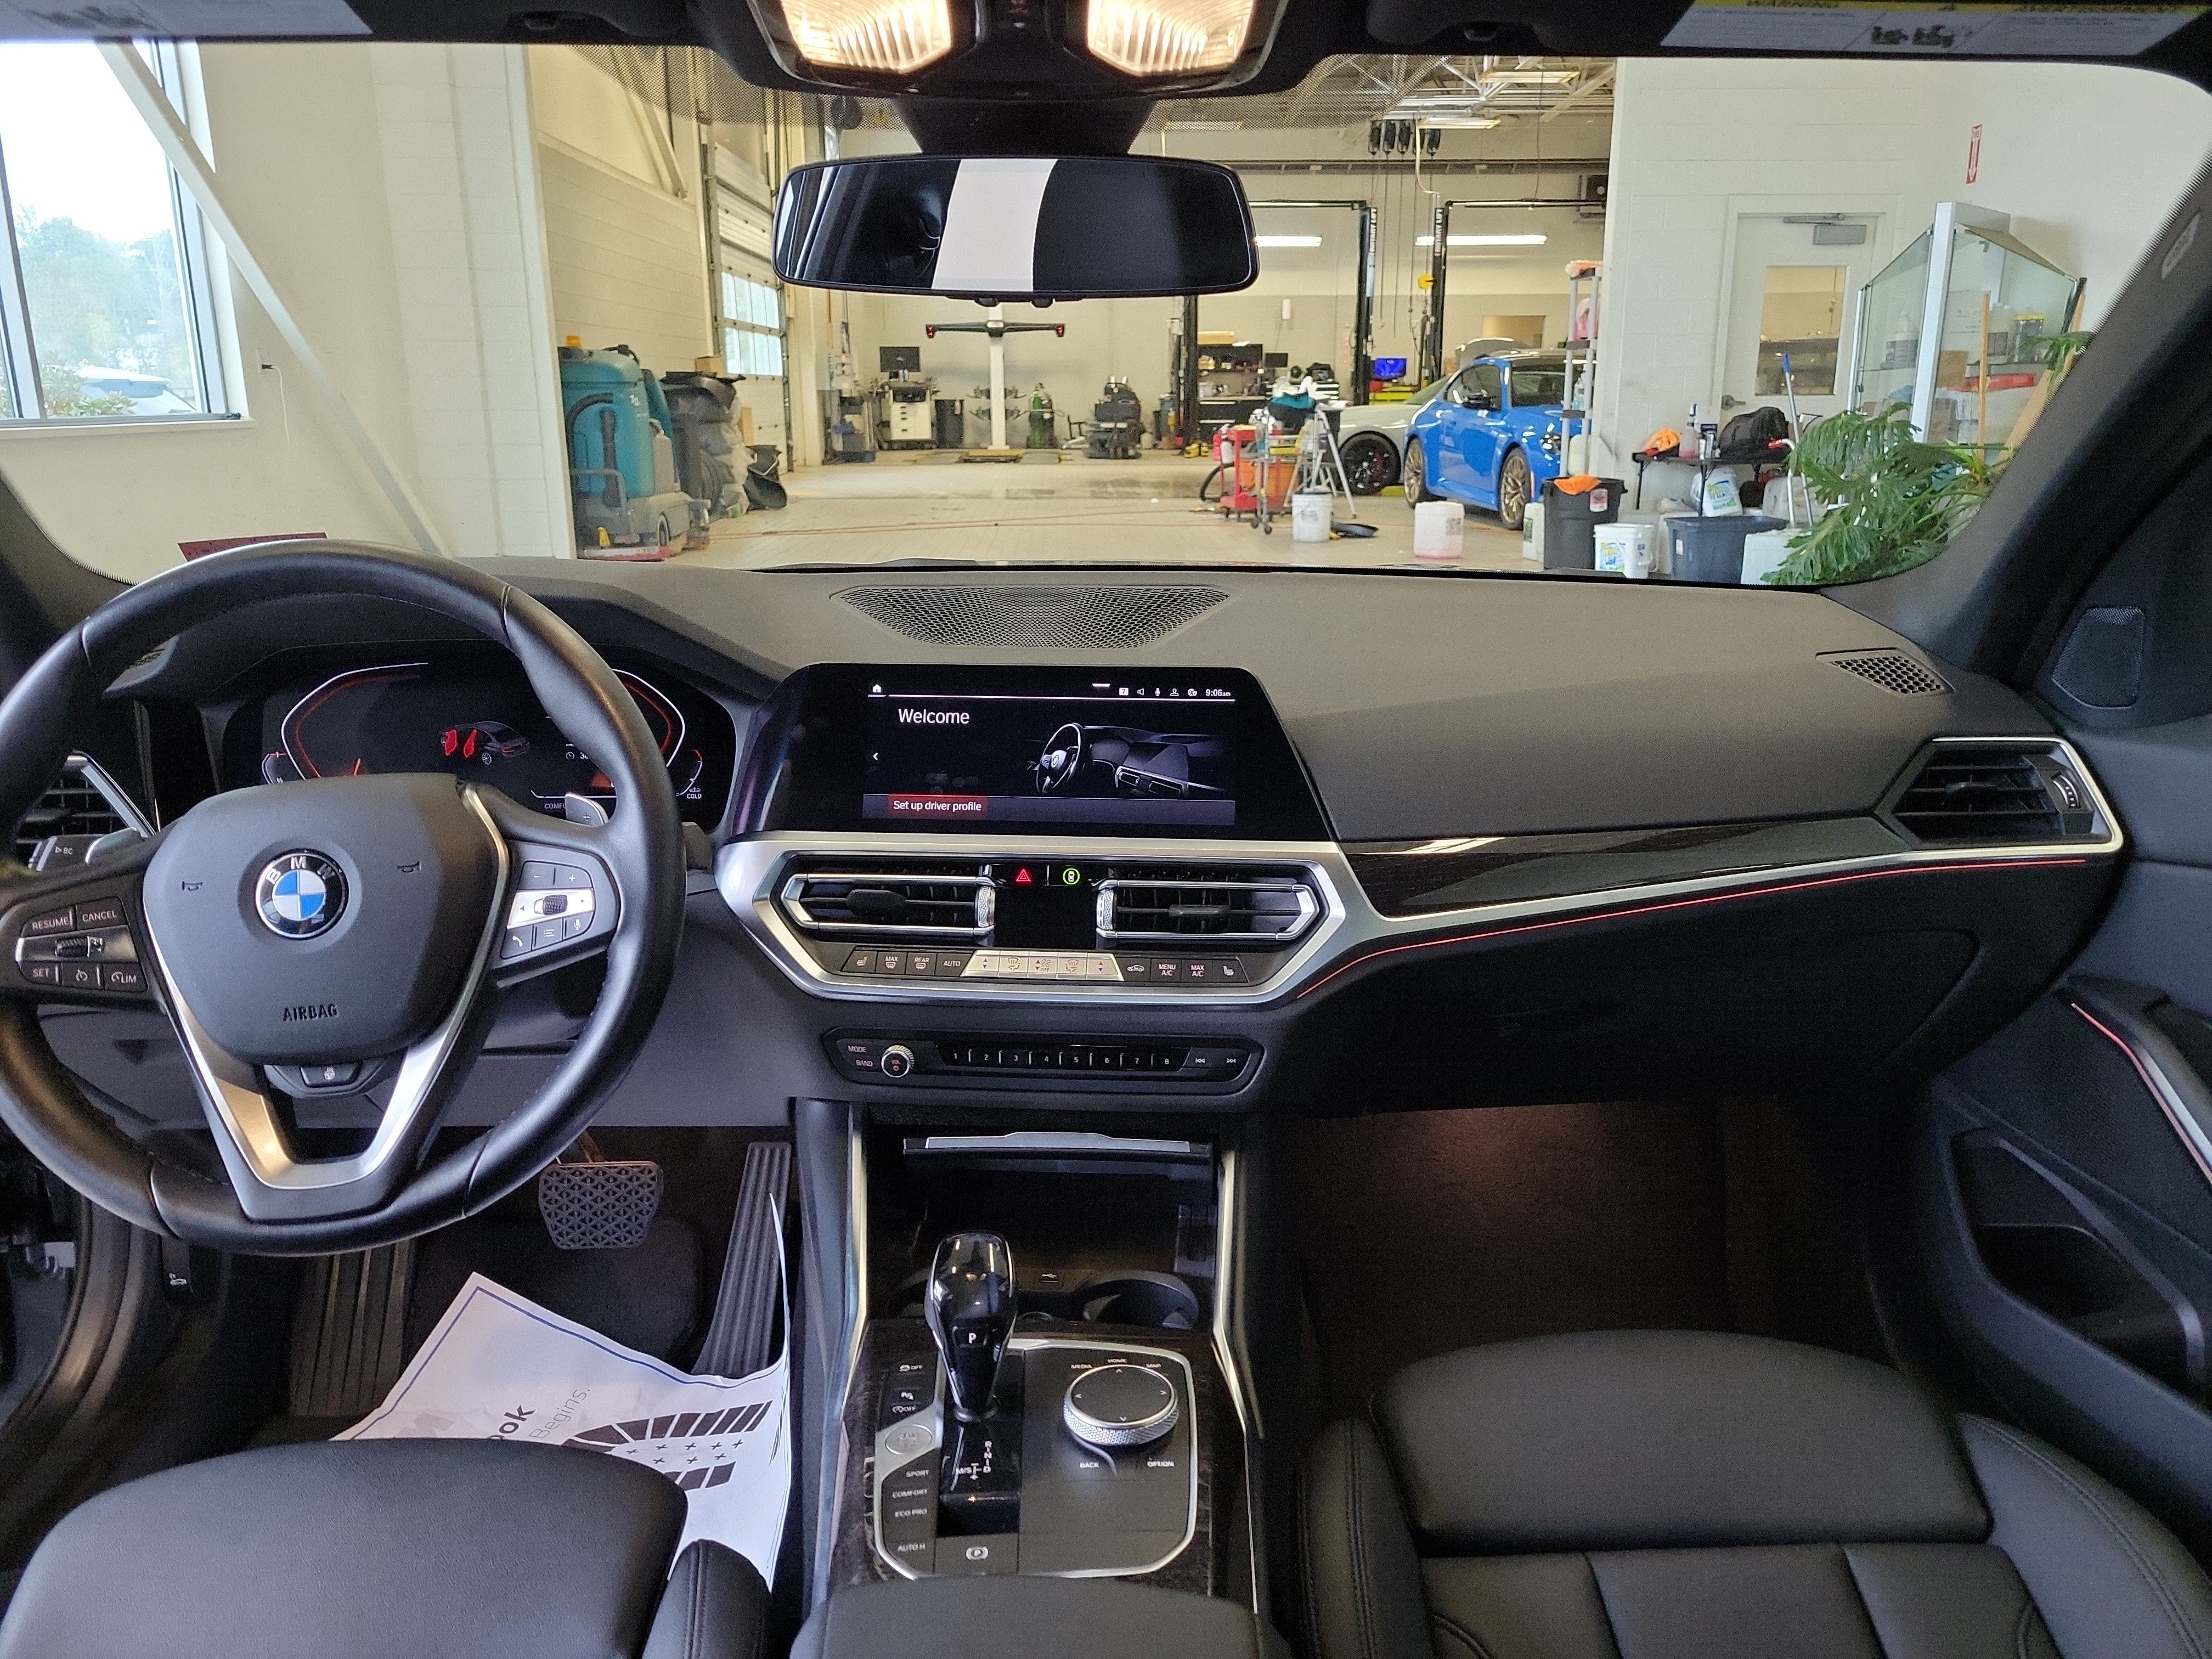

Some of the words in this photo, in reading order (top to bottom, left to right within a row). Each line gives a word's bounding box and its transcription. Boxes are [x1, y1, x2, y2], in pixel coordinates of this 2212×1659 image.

[1205, 689, 1231, 697] 9:06am
[898, 708, 970, 724] Welcome
[893, 800, 909, 810] Set
[911, 802, 923, 811] up
[924, 801, 951, 811] driver
[952, 802, 982, 812] profile
[265, 855, 336, 885] BMW
[82, 910, 117, 923] CANCEL
[31, 917, 69, 930] RESUME
[32, 968, 49, 978] SET
[121, 972, 137, 984] LIM
[283, 1003, 338, 1022] AIRBAG
[968, 1332, 977, 1344] P
[528, 1389, 591, 1438] Begins.
[892, 1488, 928, 1498] COMFORT
[895, 1510, 911, 1518] ECO
[897, 1543, 918, 1552] AUTO
